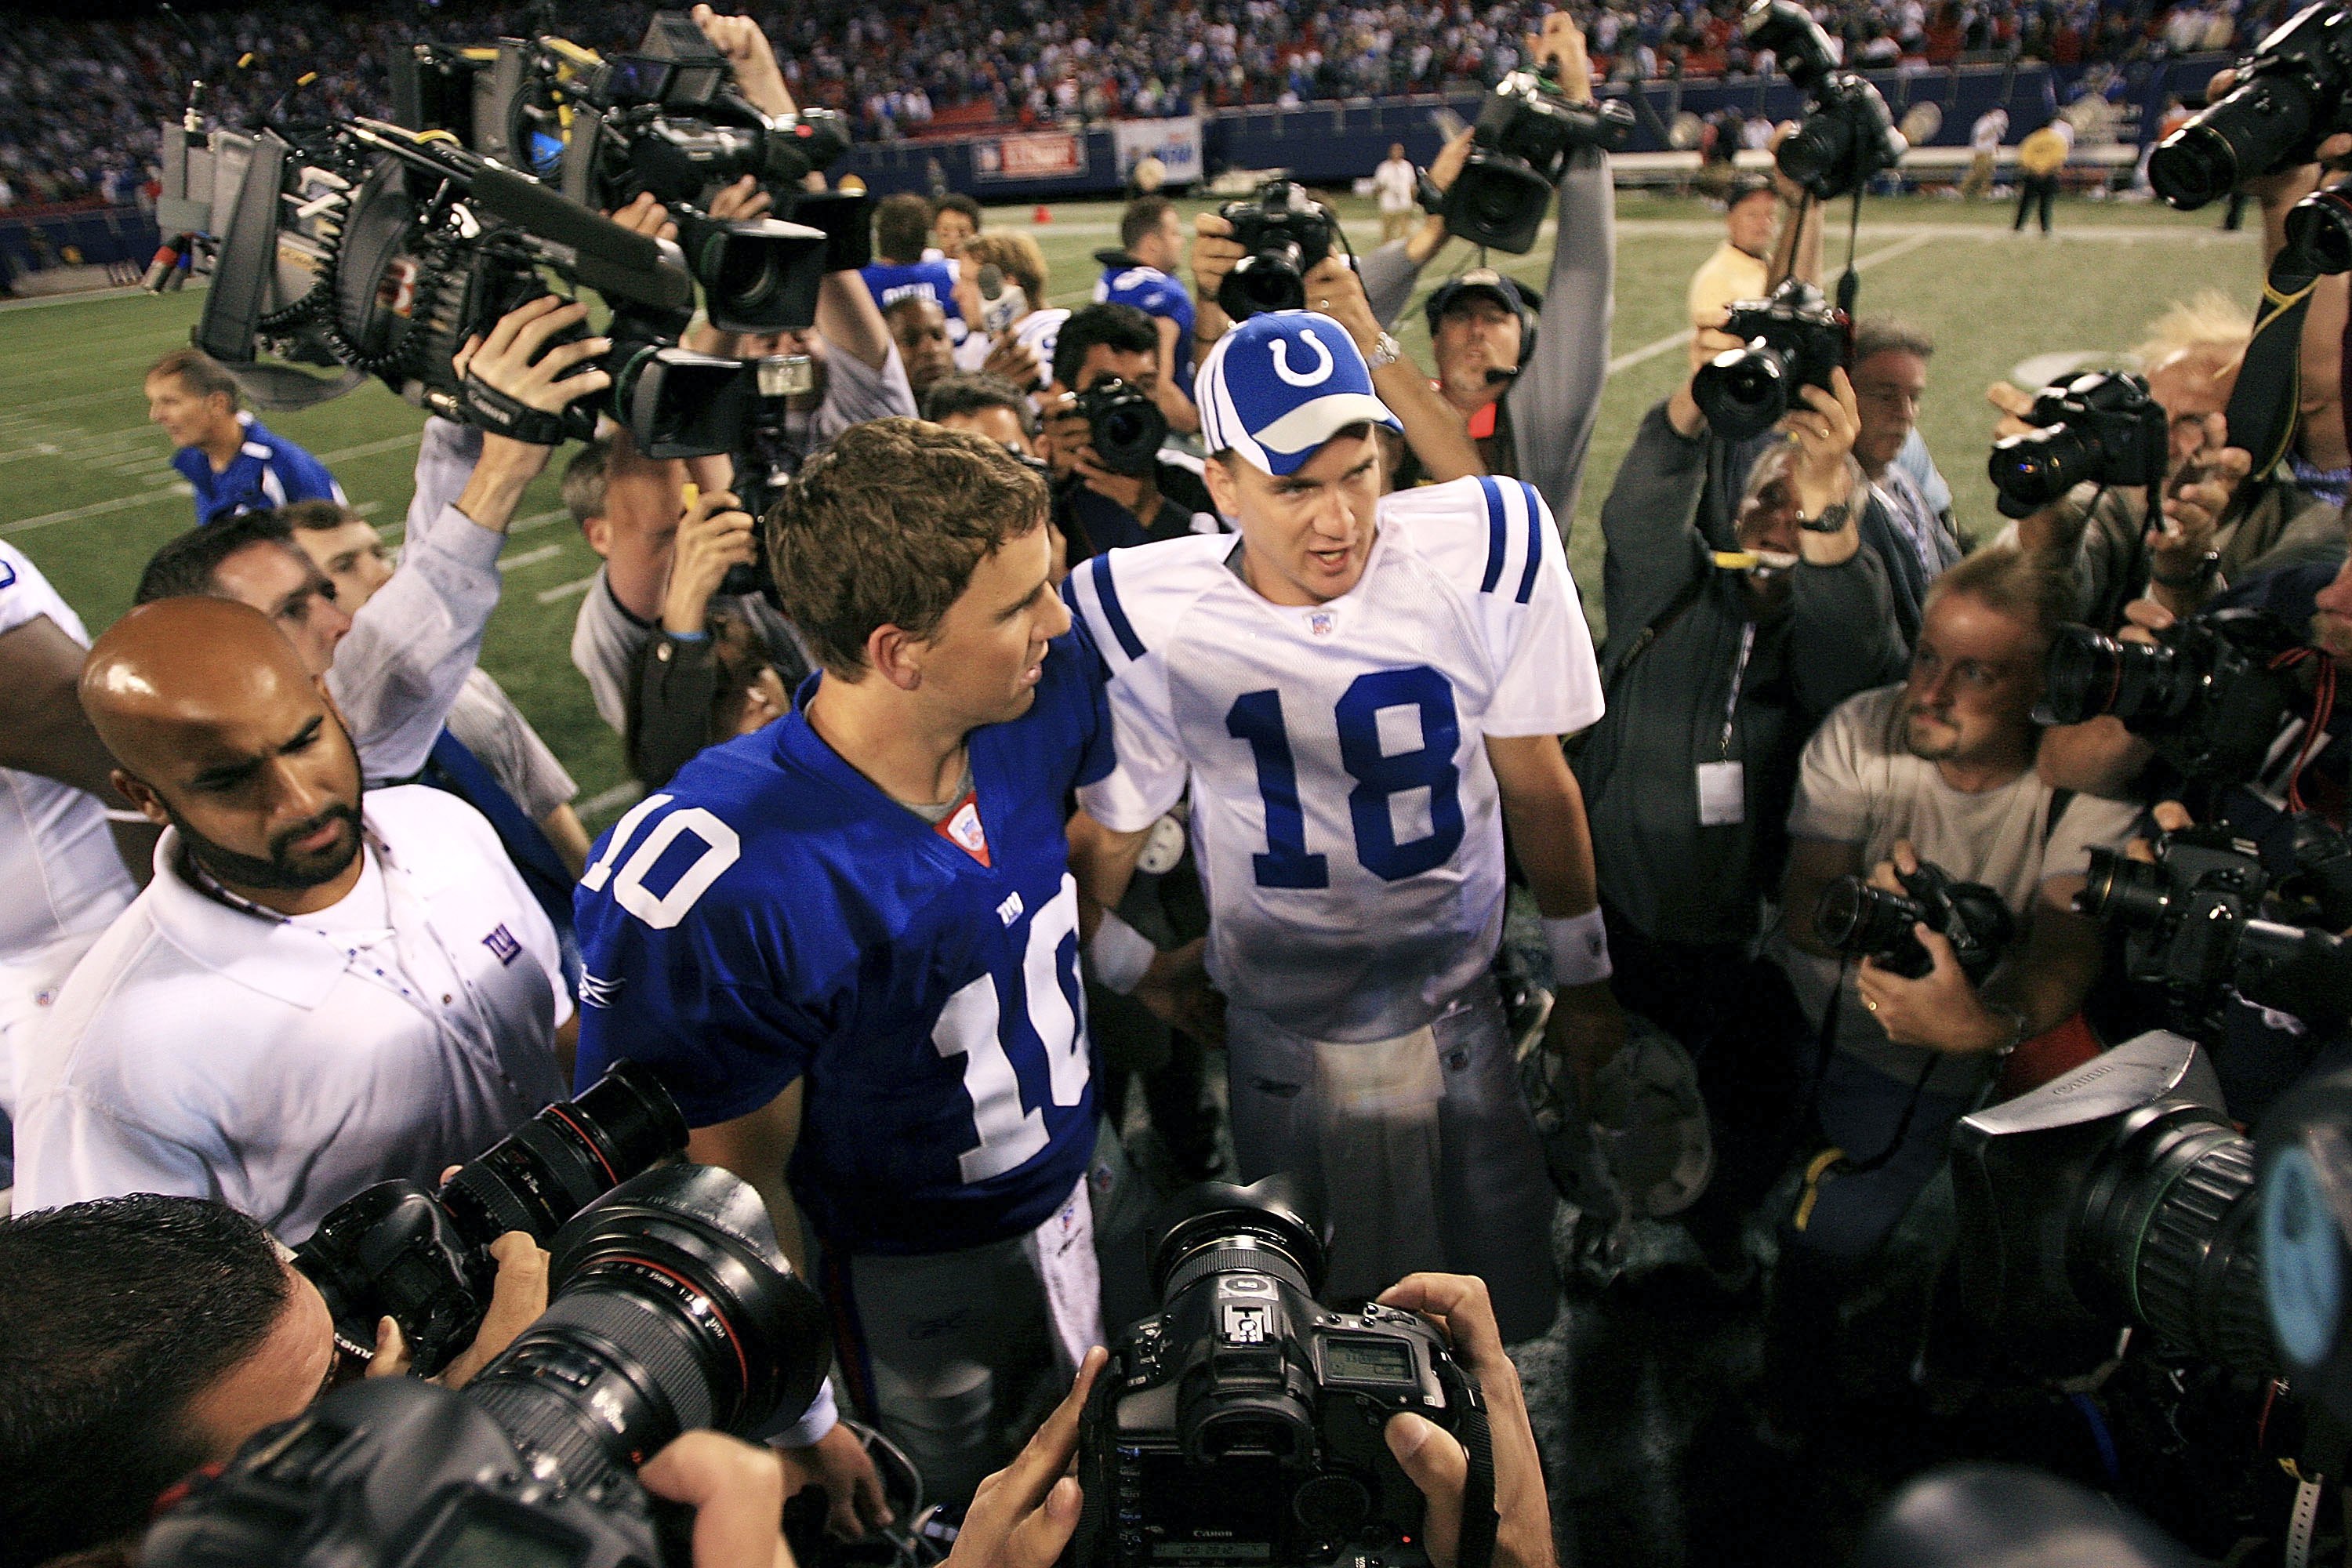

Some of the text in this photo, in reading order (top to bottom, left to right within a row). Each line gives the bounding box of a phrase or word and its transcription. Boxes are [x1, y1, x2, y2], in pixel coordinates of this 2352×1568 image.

[580, 793, 740, 930] 10
[1225, 666, 1466, 888] 18
[931, 872, 1091, 1185] 10
